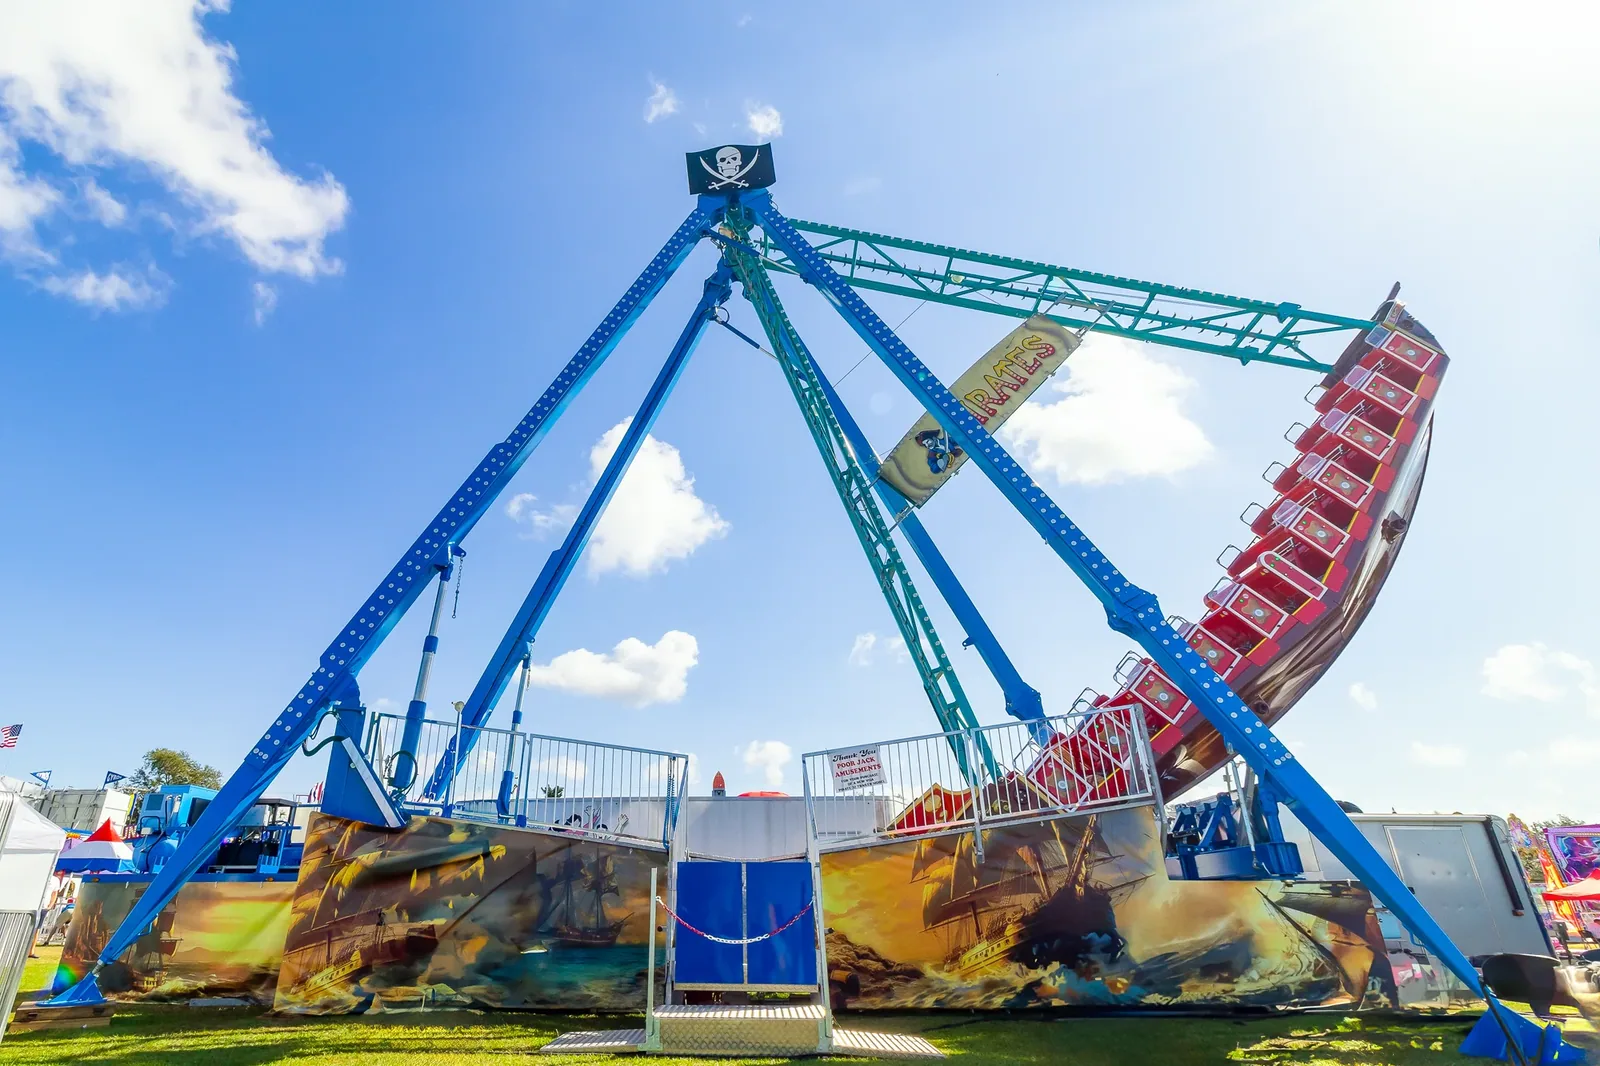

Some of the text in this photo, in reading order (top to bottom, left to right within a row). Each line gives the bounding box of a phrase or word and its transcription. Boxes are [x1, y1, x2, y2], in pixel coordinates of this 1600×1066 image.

[960, 334, 1056, 425] IRATES
[832, 749, 876, 762] Thank You
[835, 763, 882, 778] AMUSEMENTS
[837, 761, 856, 769] POOR
